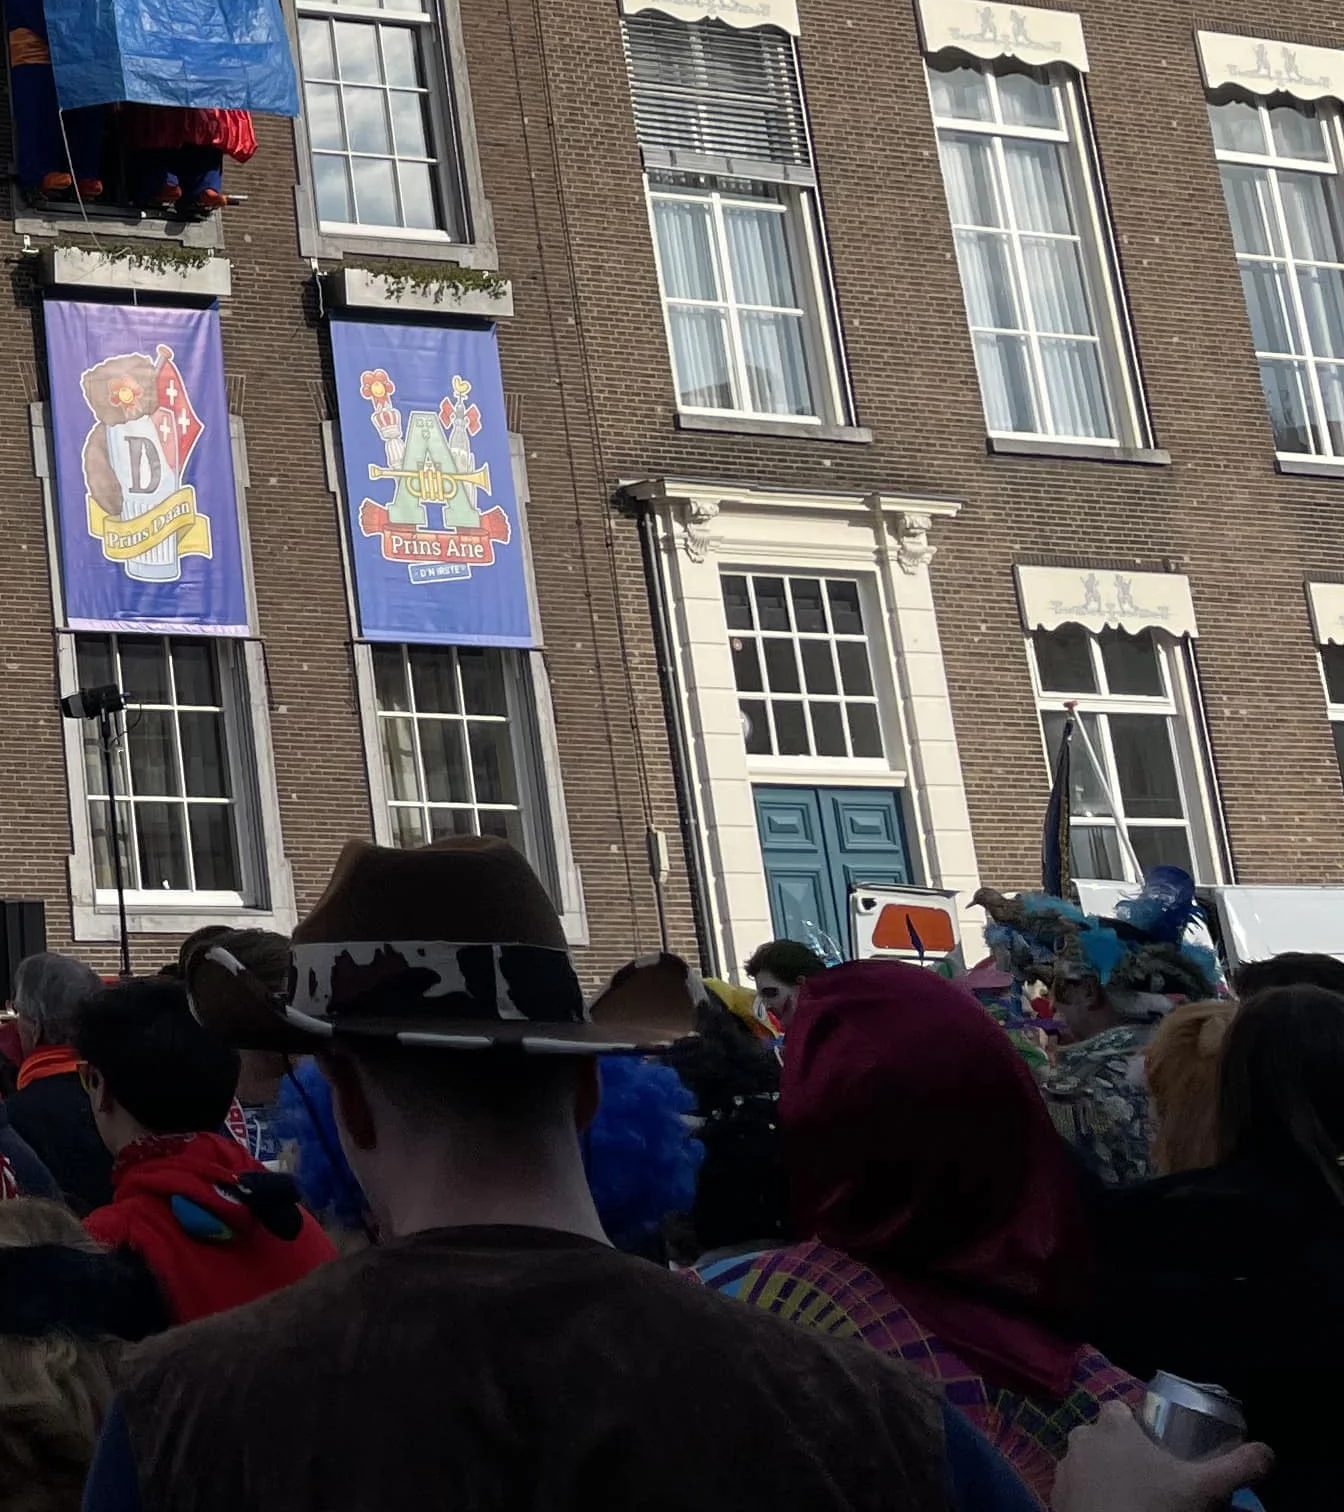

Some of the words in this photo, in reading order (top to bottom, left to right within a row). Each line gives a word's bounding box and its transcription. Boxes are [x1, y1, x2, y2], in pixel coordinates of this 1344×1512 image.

[106, 527, 150, 549] Prins
[151, 501, 192, 535] Daan
[391, 535, 442, 557] Prins
[446, 538, 484, 558] Arie
